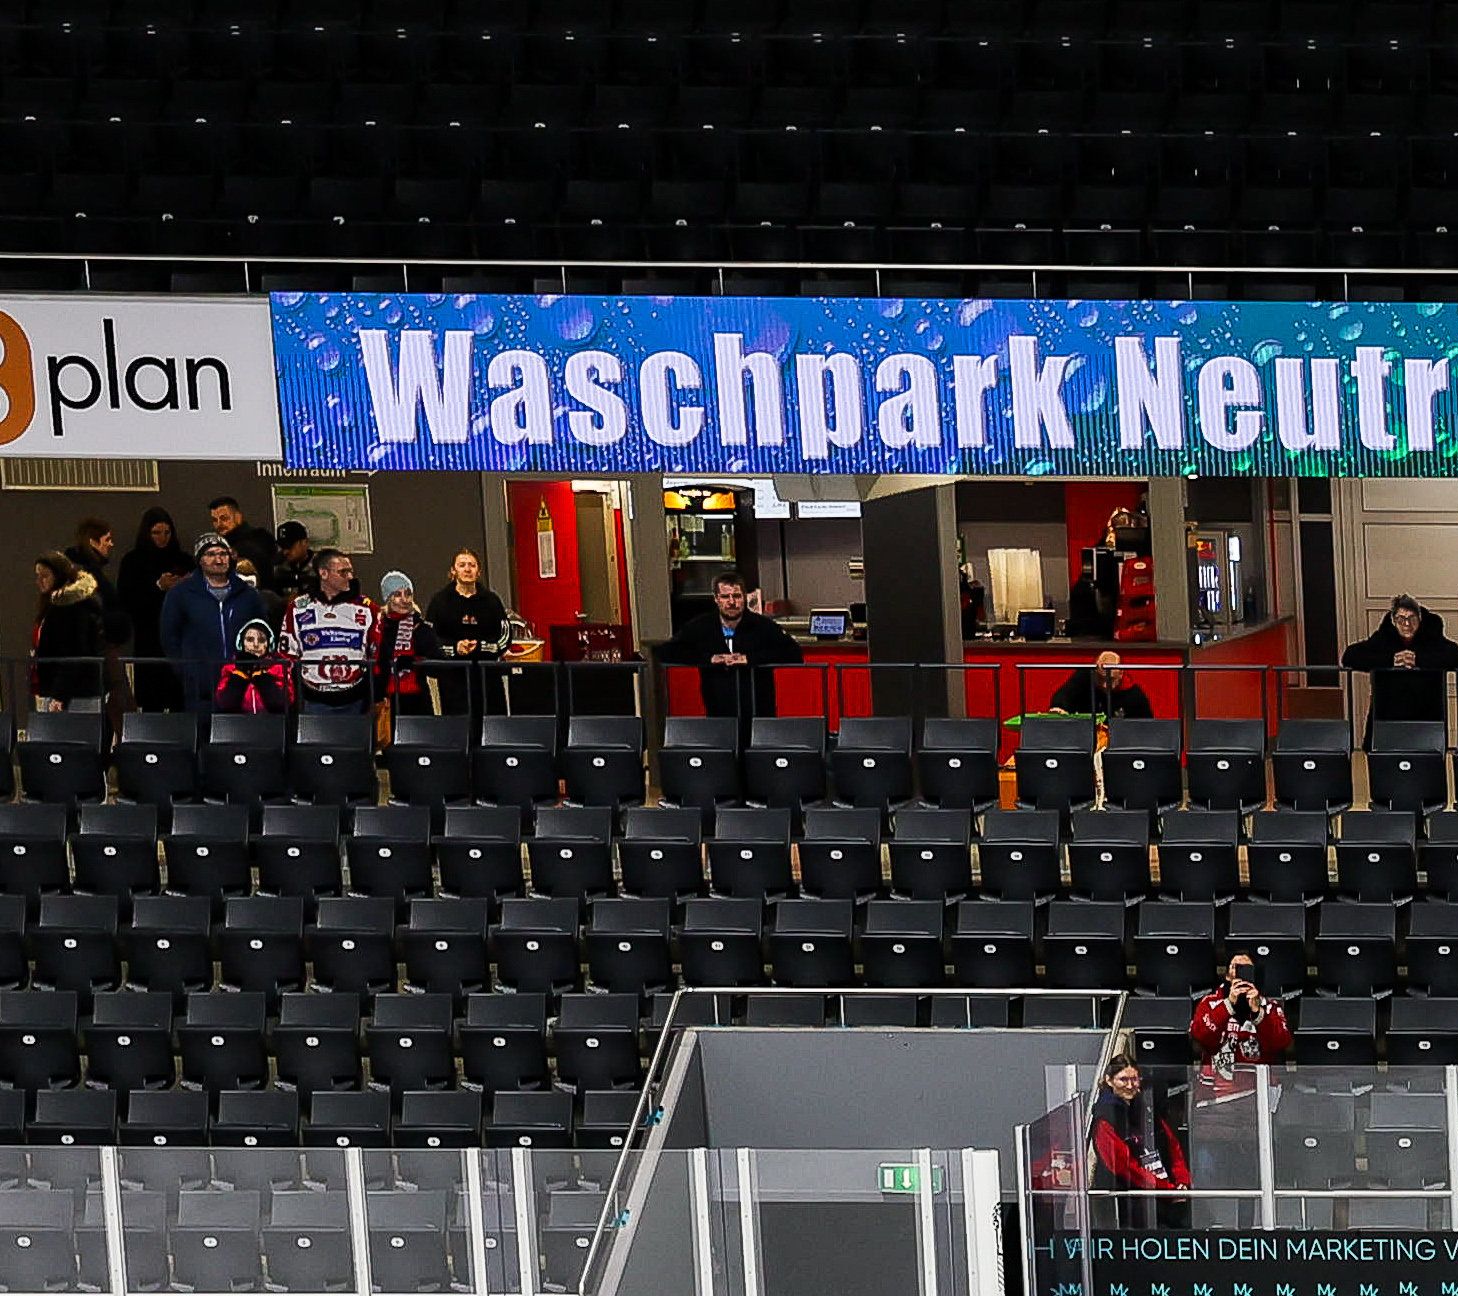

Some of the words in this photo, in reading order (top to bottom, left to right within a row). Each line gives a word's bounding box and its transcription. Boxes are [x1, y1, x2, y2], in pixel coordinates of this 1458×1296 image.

[48, 318, 232, 437] plan
[358, 329, 1076, 460] Waschpark
[1122, 1239, 1210, 1261] HOLEN
[1218, 1239, 1277, 1261] DEIN
[1286, 1239, 1436, 1262] MARKETING
